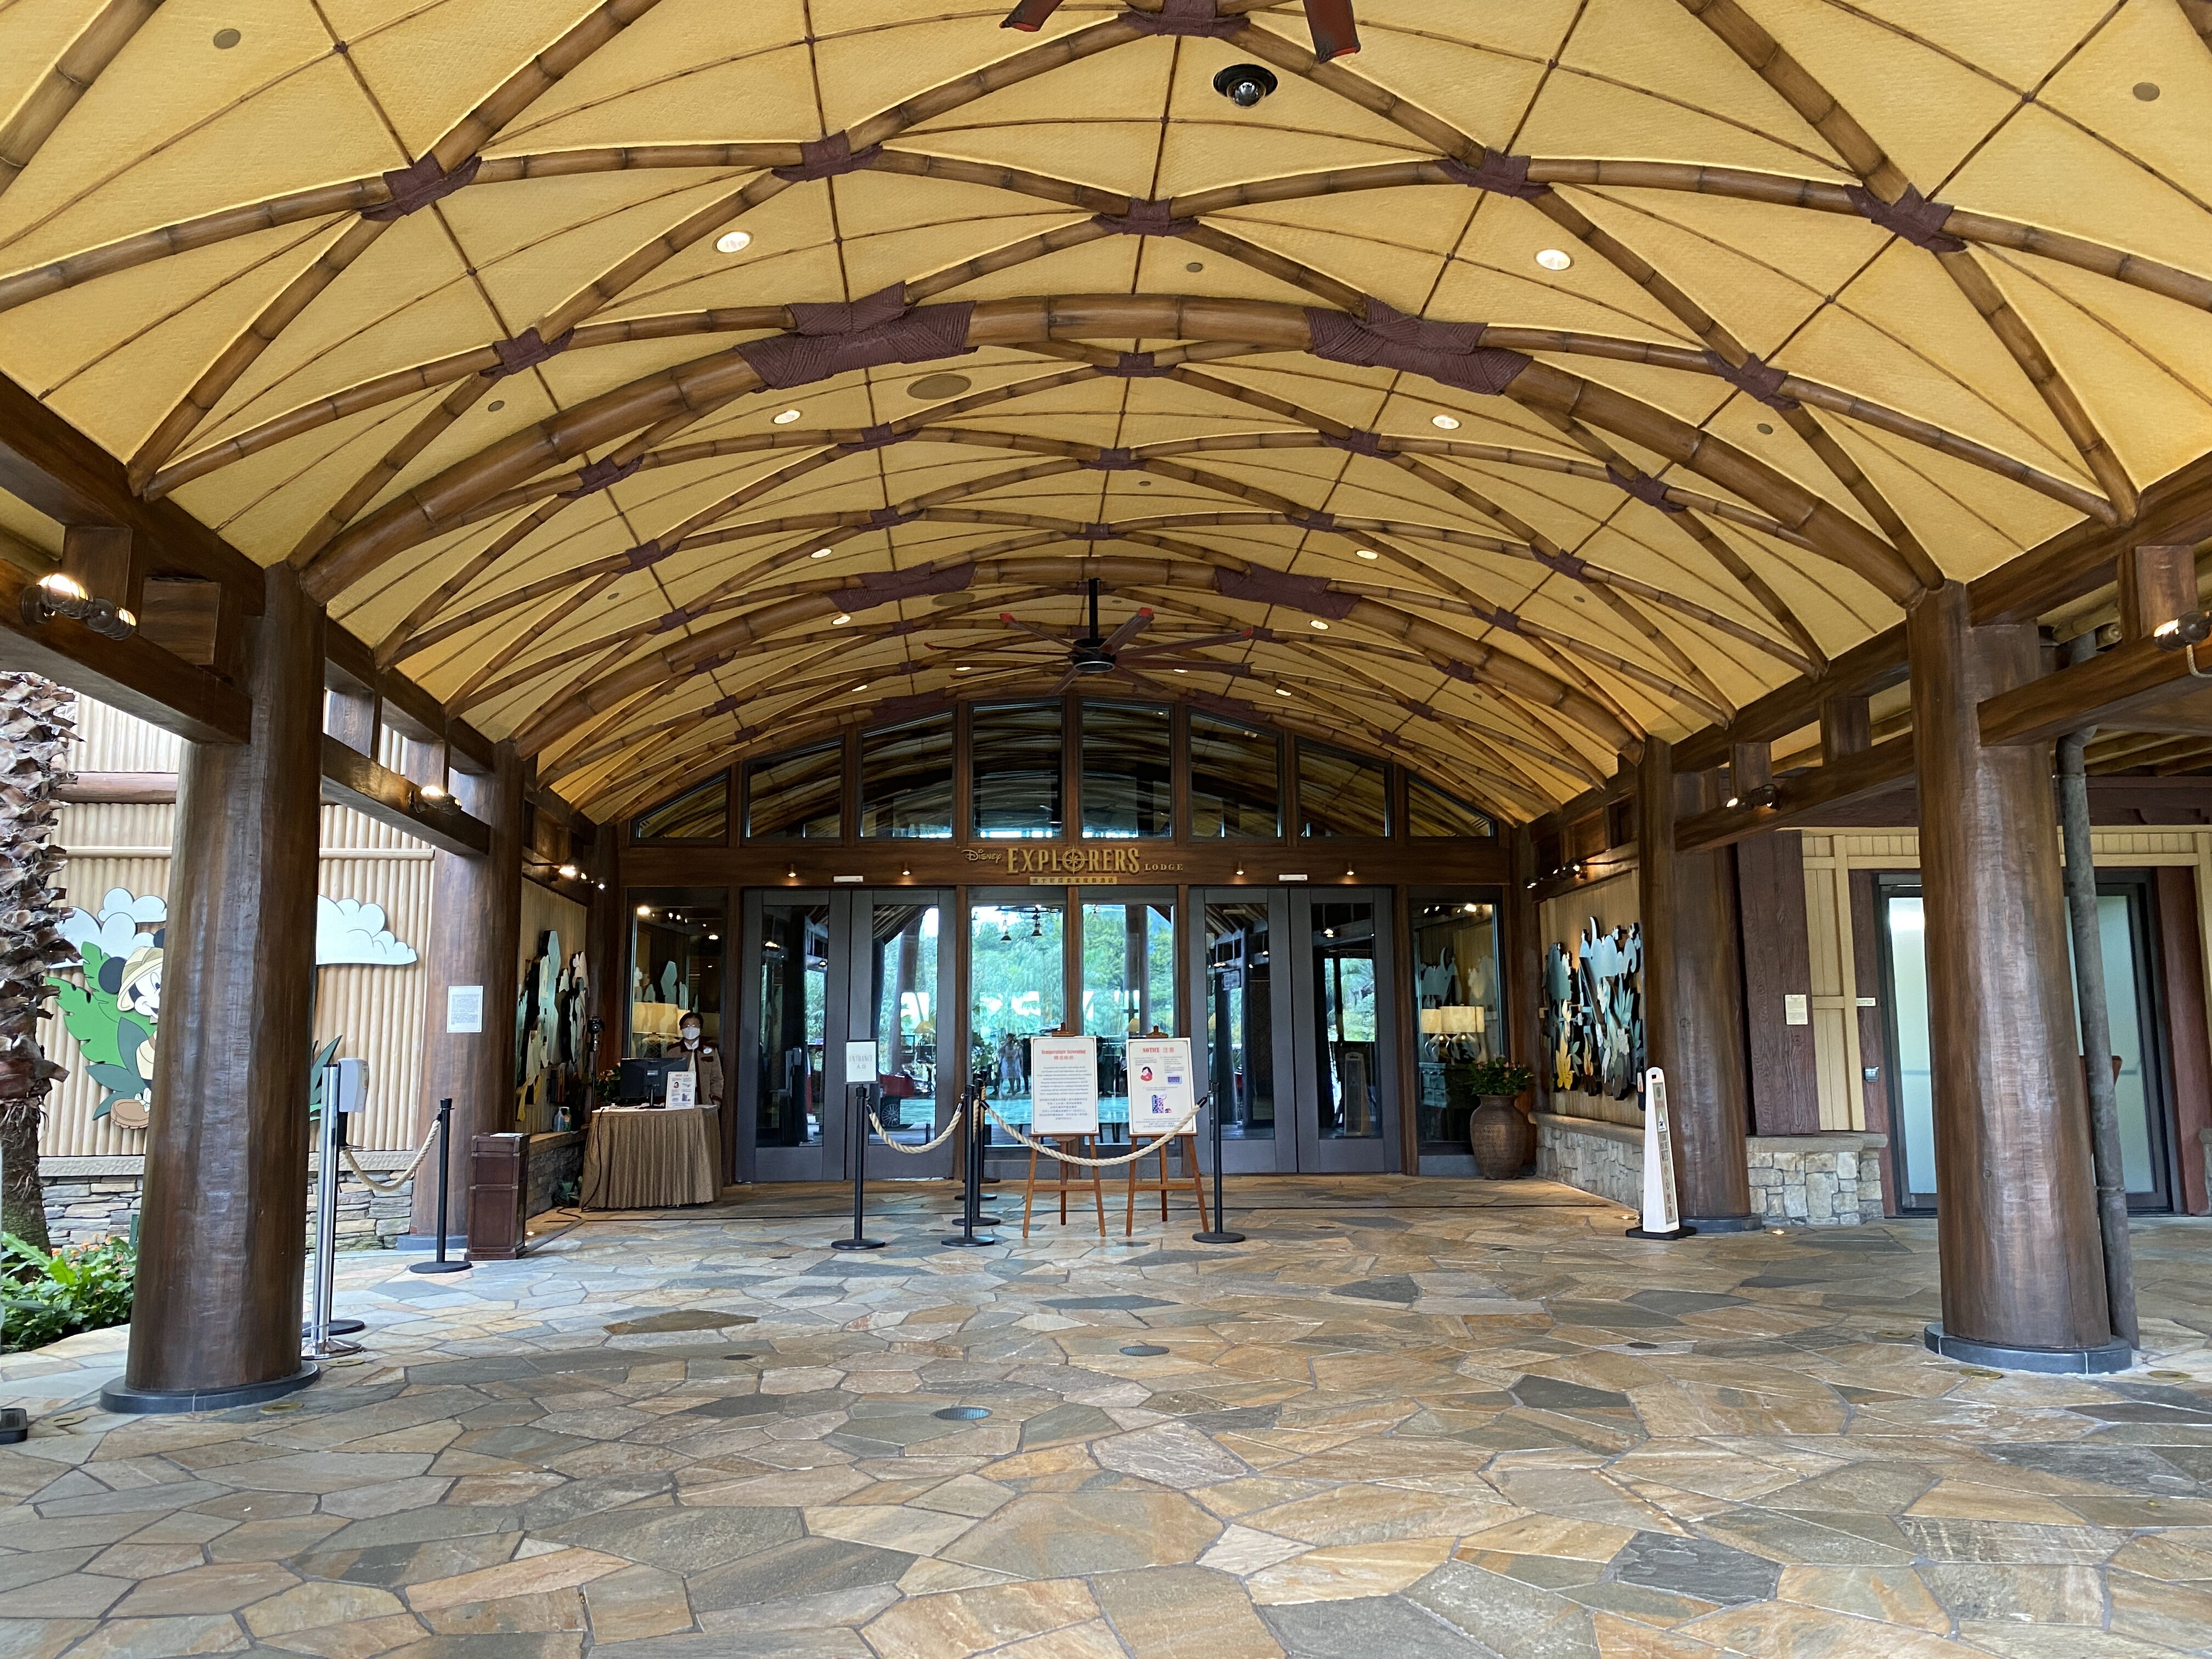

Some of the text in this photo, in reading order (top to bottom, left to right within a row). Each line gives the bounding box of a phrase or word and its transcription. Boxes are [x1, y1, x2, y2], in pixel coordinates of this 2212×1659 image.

[961, 847, 1183, 874] Disney EXPLORERS LODGE
